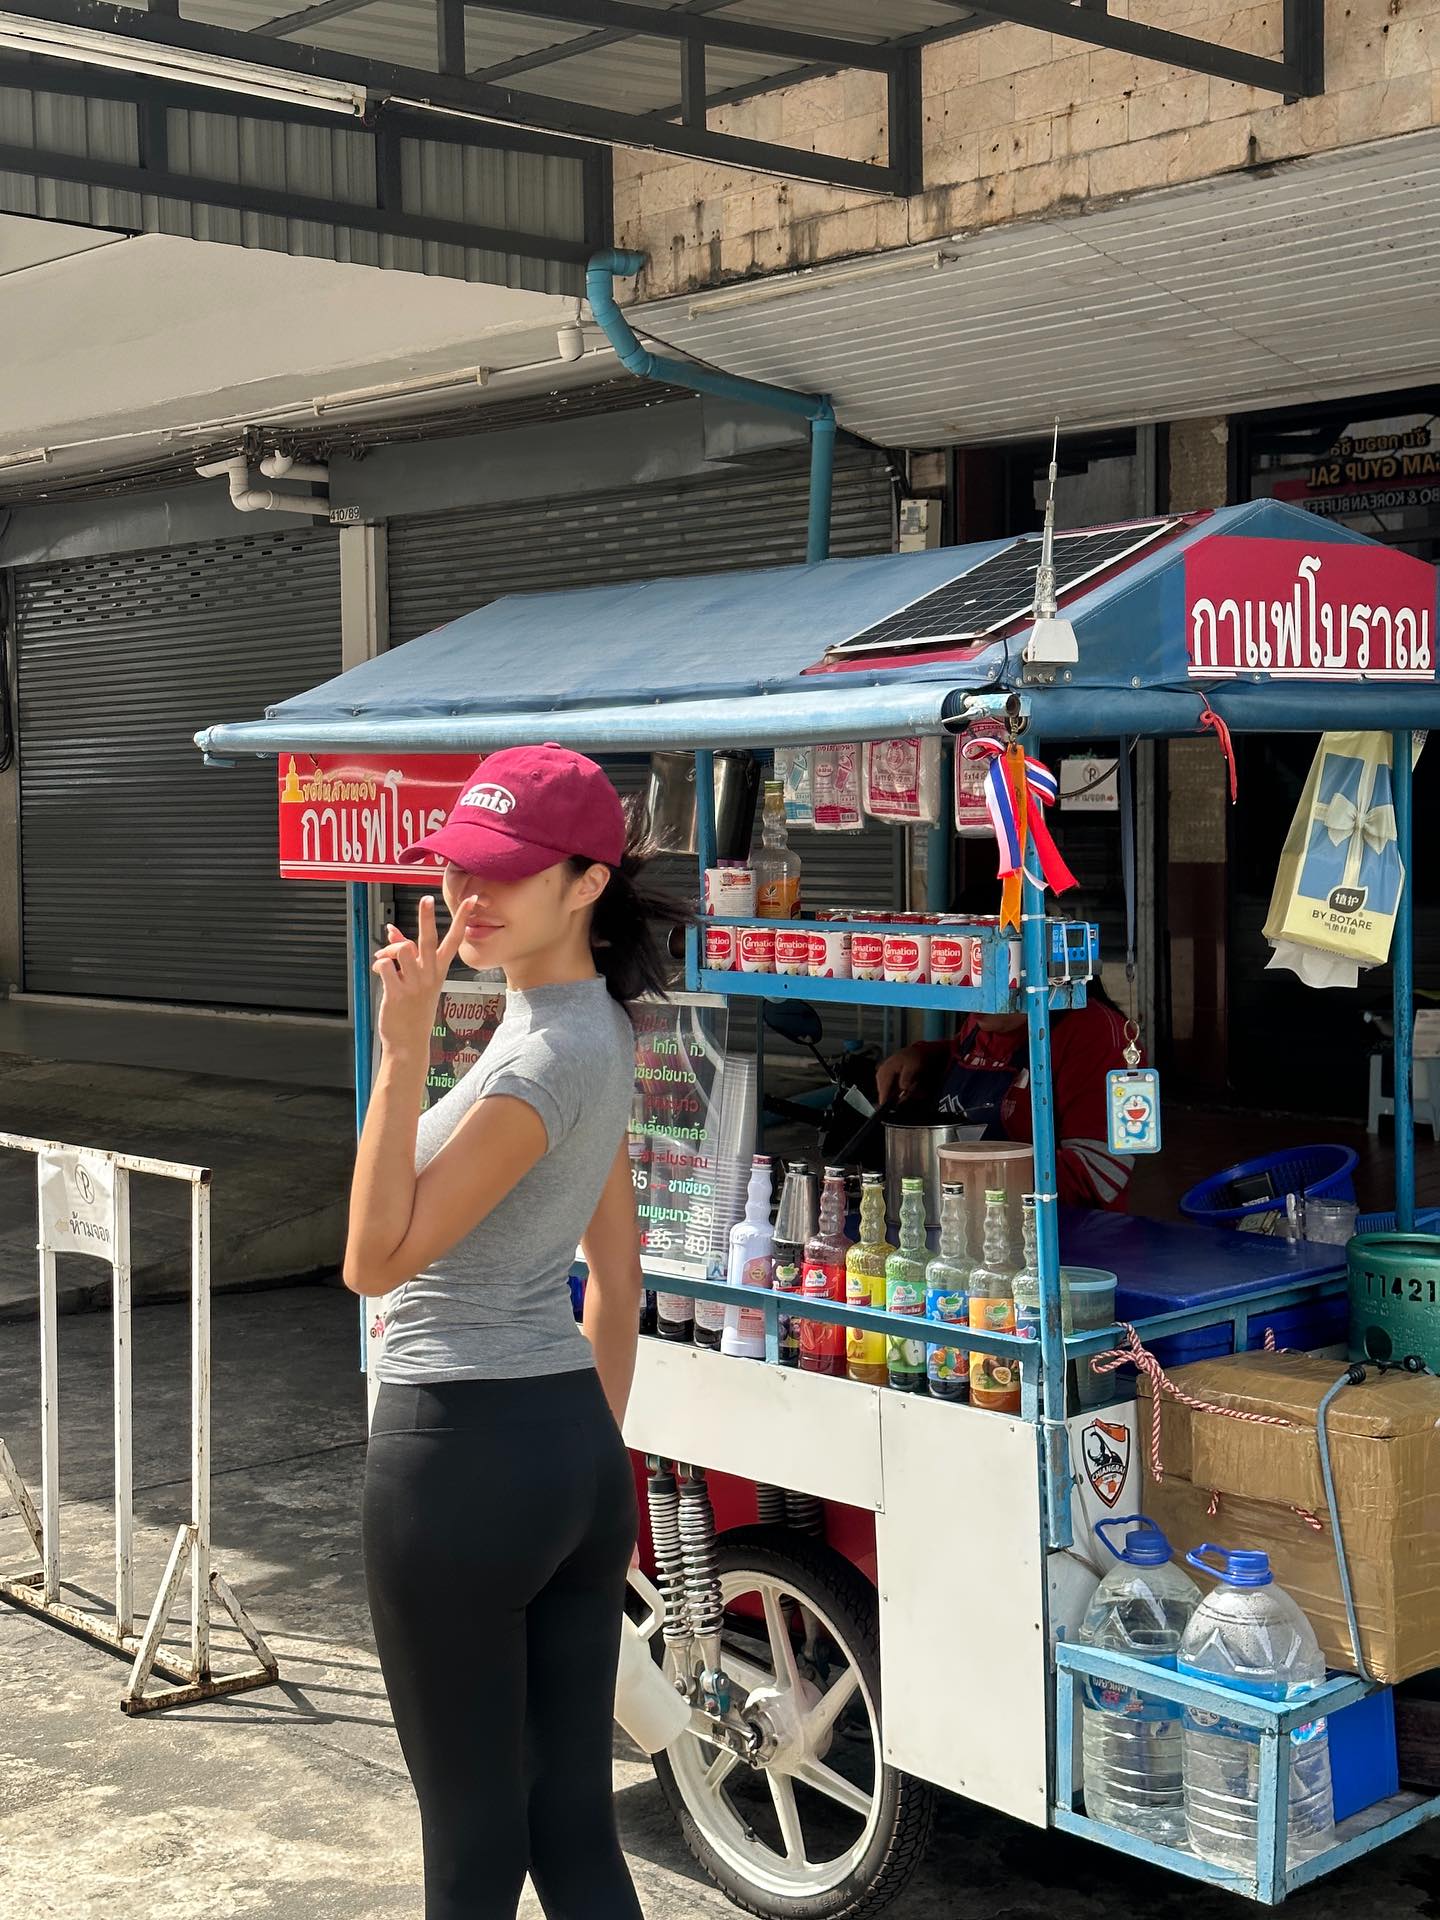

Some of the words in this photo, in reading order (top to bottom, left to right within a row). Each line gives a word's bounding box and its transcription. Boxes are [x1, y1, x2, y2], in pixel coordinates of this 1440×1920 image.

[1191, 555, 1431, 669] กาแฟโบราณ
[1335, 893, 1360, 907] 植护
[1311, 909, 1328, 919] BY
[1329, 913, 1373, 930] BOTARE
[884, 943, 917, 958] Carnation
